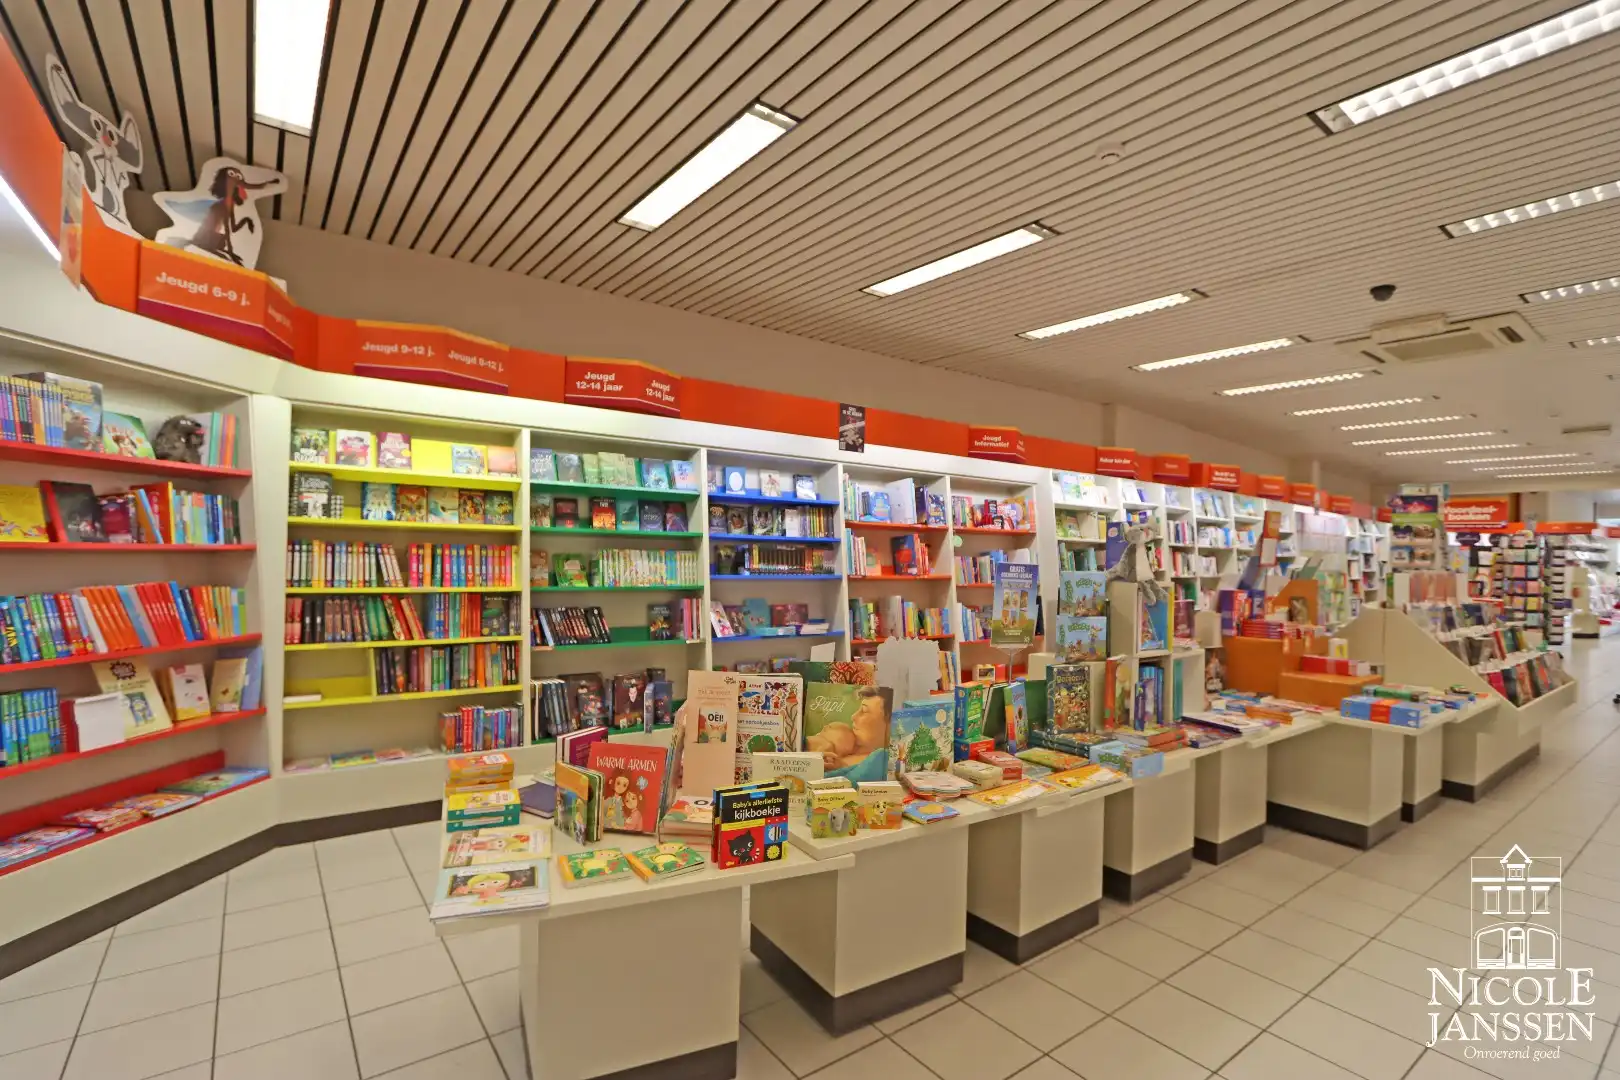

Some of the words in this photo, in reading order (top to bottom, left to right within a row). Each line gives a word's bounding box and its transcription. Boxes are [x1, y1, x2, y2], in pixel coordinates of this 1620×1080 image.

[156, 271, 209, 295] Jeugd
[212, 286, 238, 302] 6-9
[362, 341, 399, 355] Jeugd
[401, 344, 426, 356] 9-12
[448, 350, 477, 365] Jeugd
[584, 371, 616, 382] Jeugd
[575, 381, 601, 390] 12-14
[603, 382, 624, 392] jaar
[651, 380, 671, 391] Jeugd
[646, 388, 662, 398] 12-14
[662, 391, 675, 402] jaar
[982, 434, 1002, 443] Jeugd
[810, 695, 847, 720] Papa
[595, 755, 625, 770] WARME
[627, 758, 658, 773] ARMEN
[732, 800, 752, 809] Baby's
[752, 797, 784, 807] allerliefste
[734, 805, 781, 821] kijkboekje
